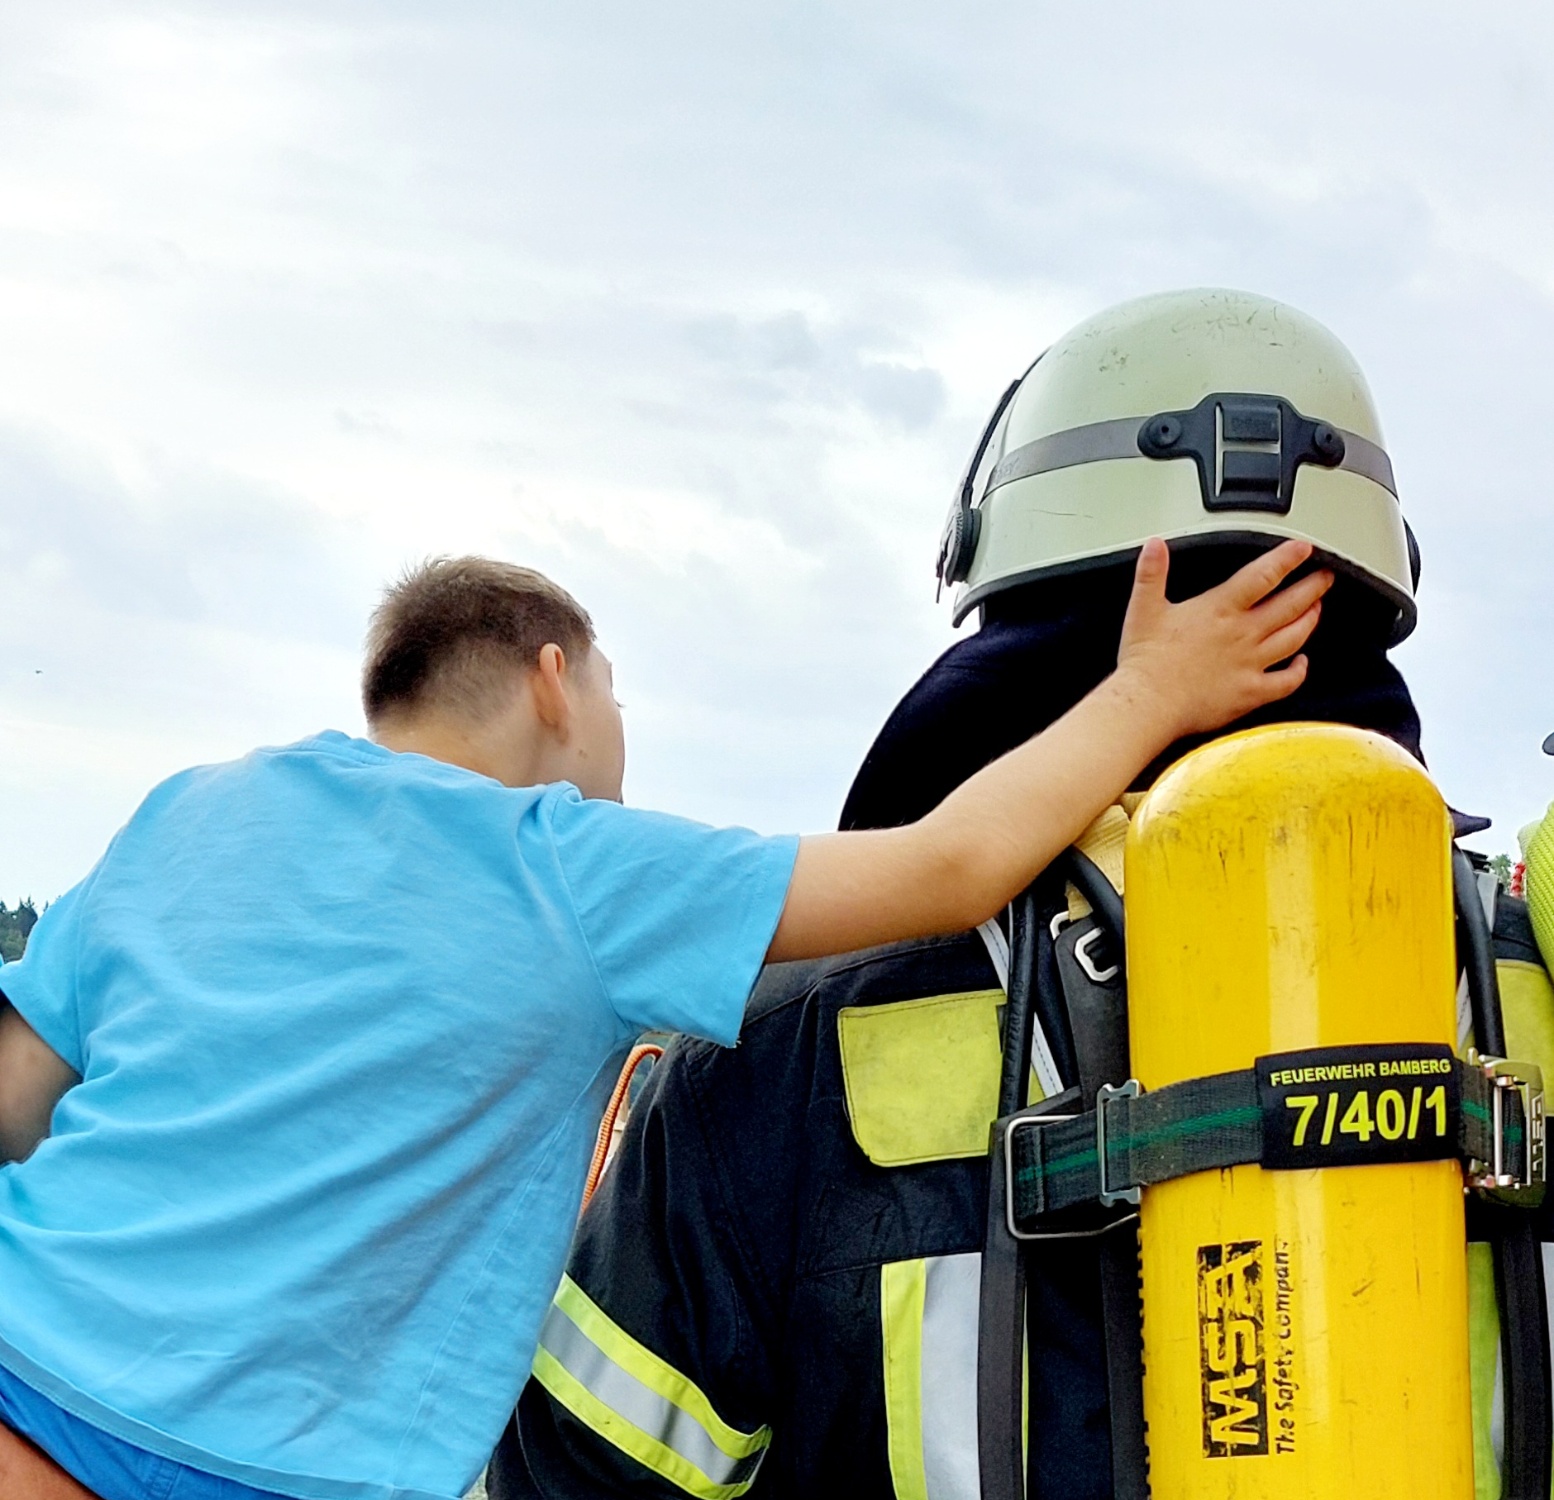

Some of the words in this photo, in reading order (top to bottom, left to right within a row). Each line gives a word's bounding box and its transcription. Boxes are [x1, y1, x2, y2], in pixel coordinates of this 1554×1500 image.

[1270, 1063, 1376, 1087] FEUERWEHR
[1379, 1058, 1451, 1077] BAMBERG
[1285, 1085, 1447, 1146] 7/40/1
[1203, 1251, 1261, 1446] MSA
[1274, 1420, 1295, 1454] The
